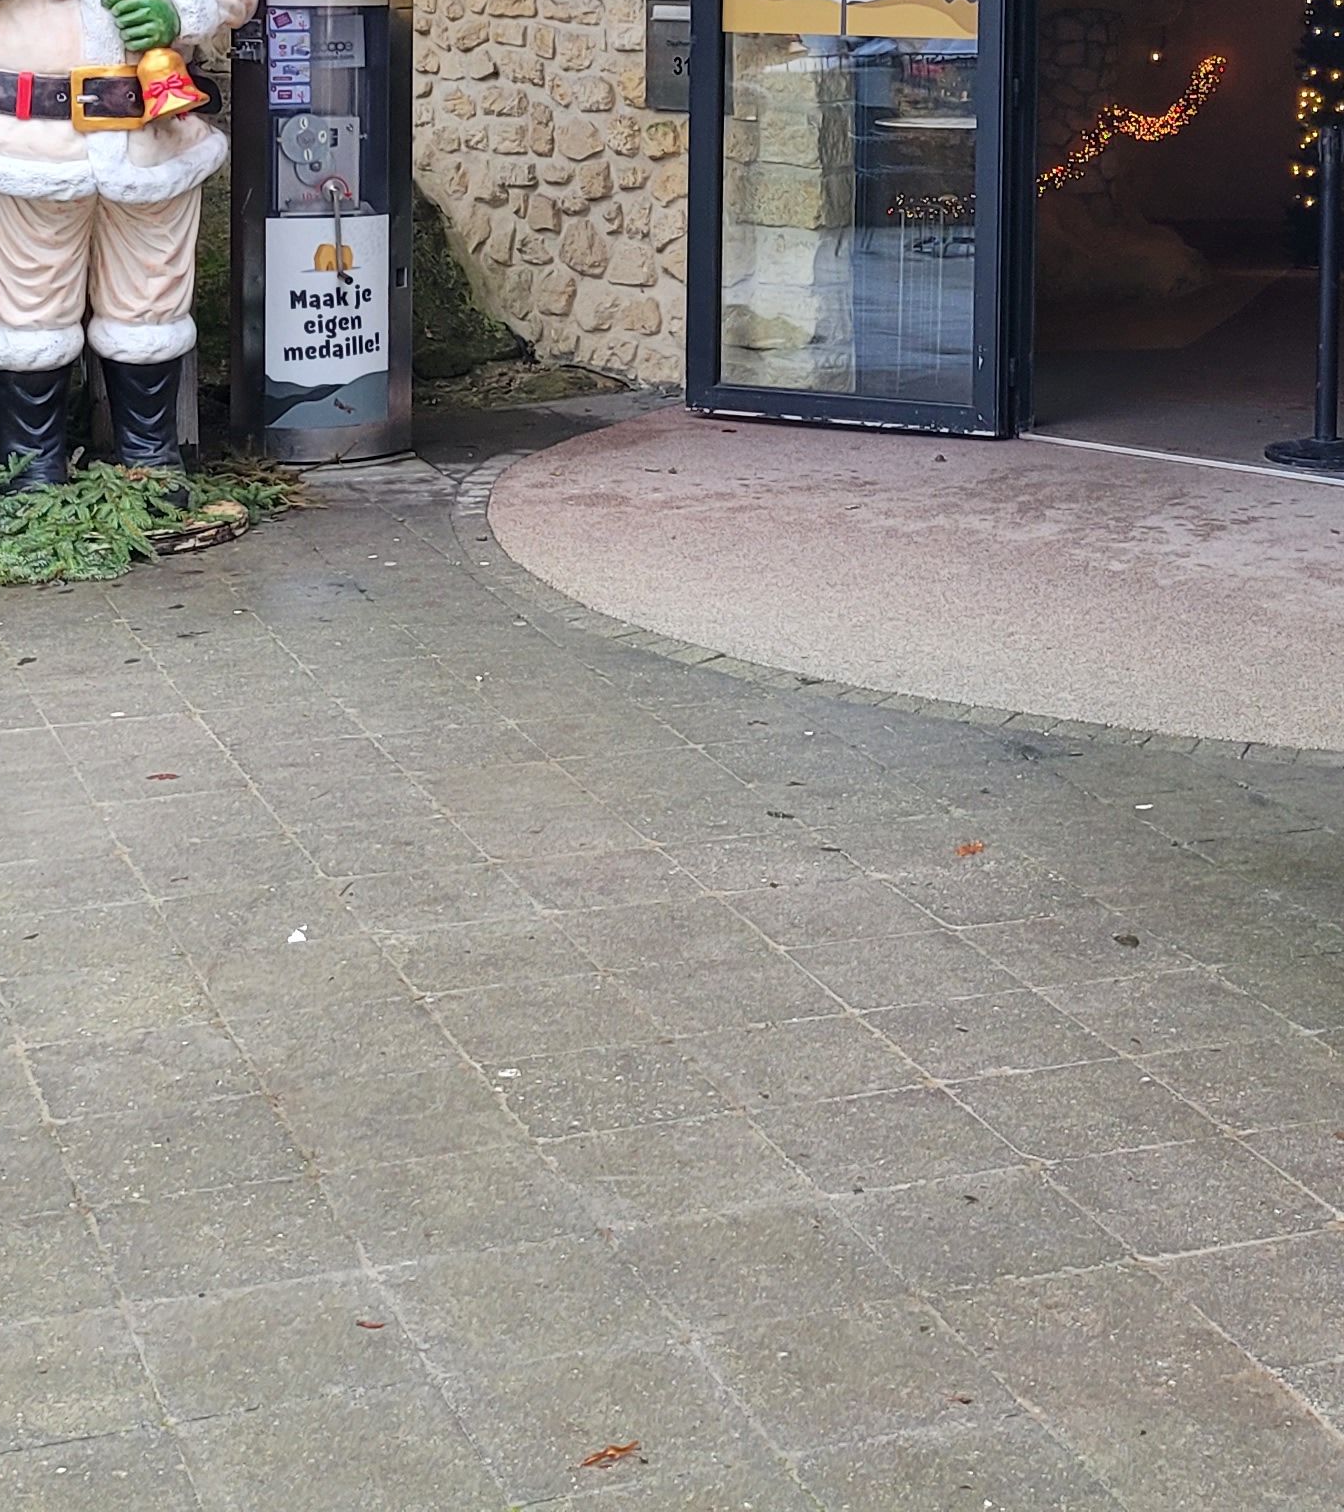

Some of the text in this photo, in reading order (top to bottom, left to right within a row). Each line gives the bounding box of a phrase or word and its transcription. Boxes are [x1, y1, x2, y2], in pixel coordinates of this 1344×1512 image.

[289, 284, 372, 310] Maak je
[303, 313, 362, 339] eigen
[283, 331, 380, 362] medaille!
